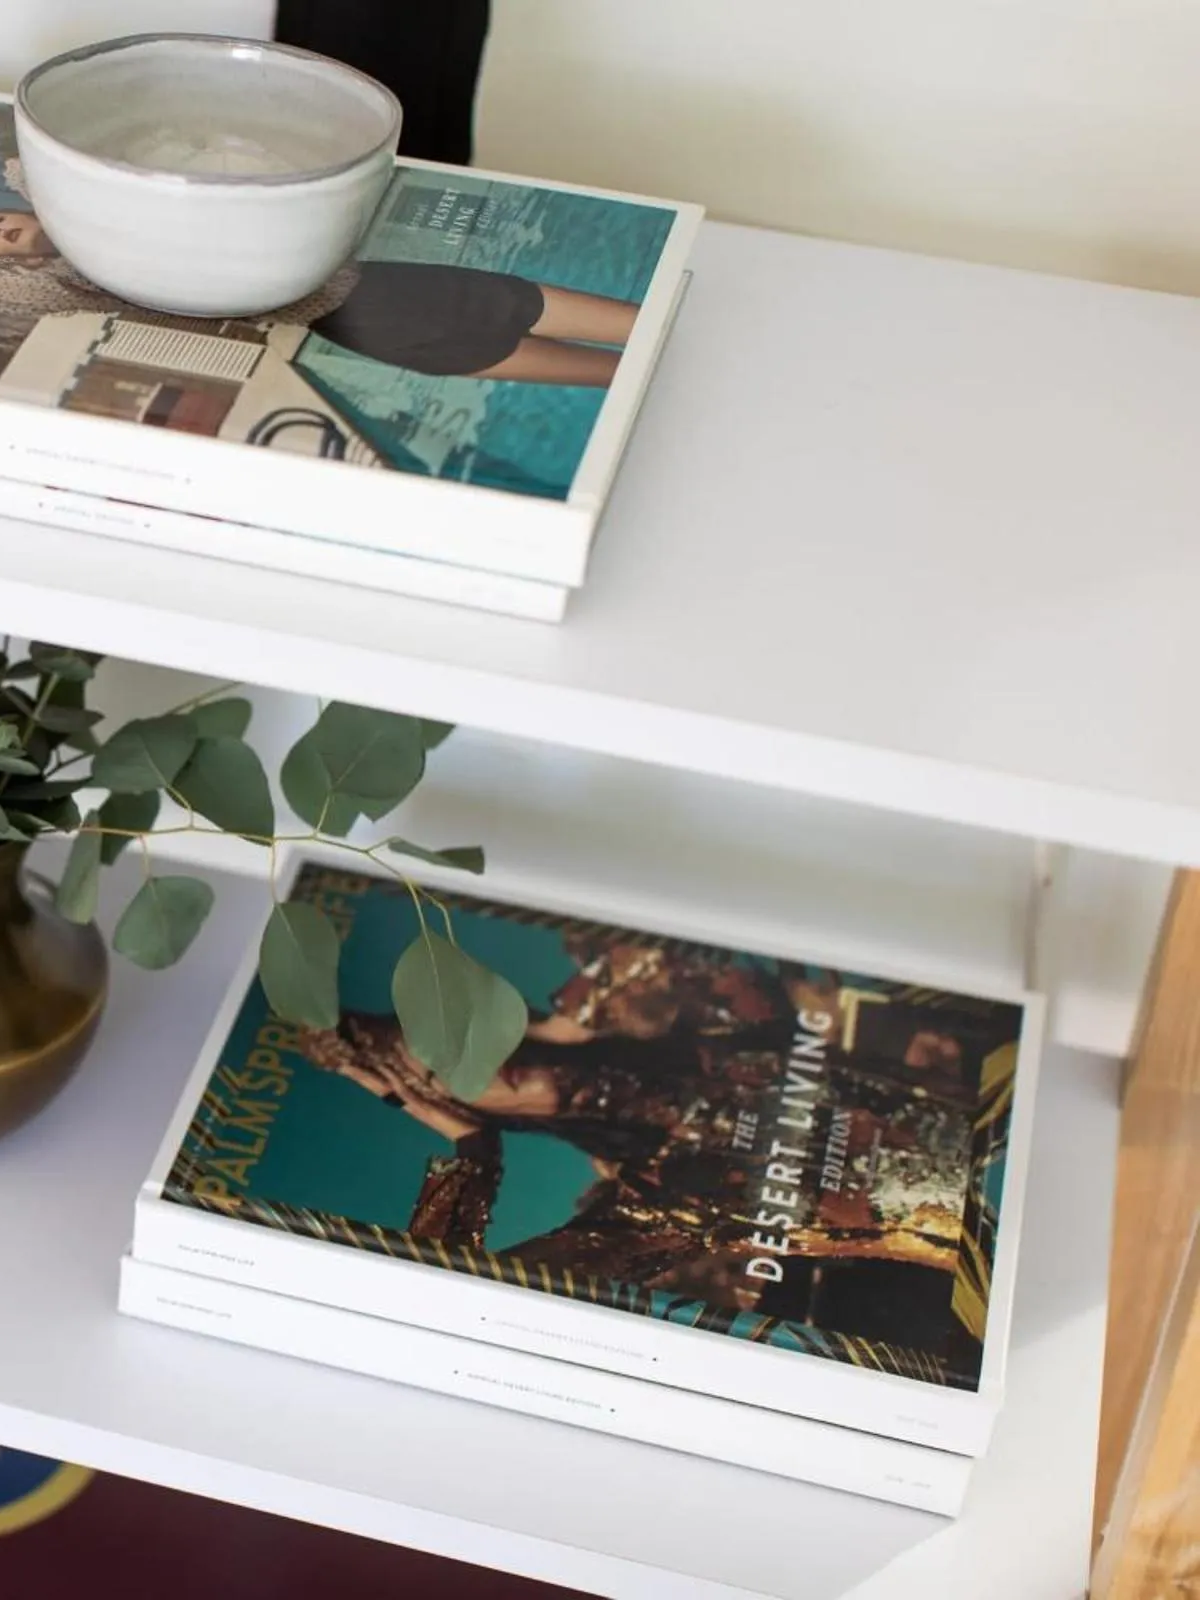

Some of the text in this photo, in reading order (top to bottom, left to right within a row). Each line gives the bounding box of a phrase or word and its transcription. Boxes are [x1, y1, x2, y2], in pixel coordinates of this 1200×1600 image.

[193, 1101, 282, 1206] PALM
[733, 1110, 759, 1150] THE
[746, 1007, 833, 1284] DESERT LIVING
[820, 1106, 852, 1193] EDITION
